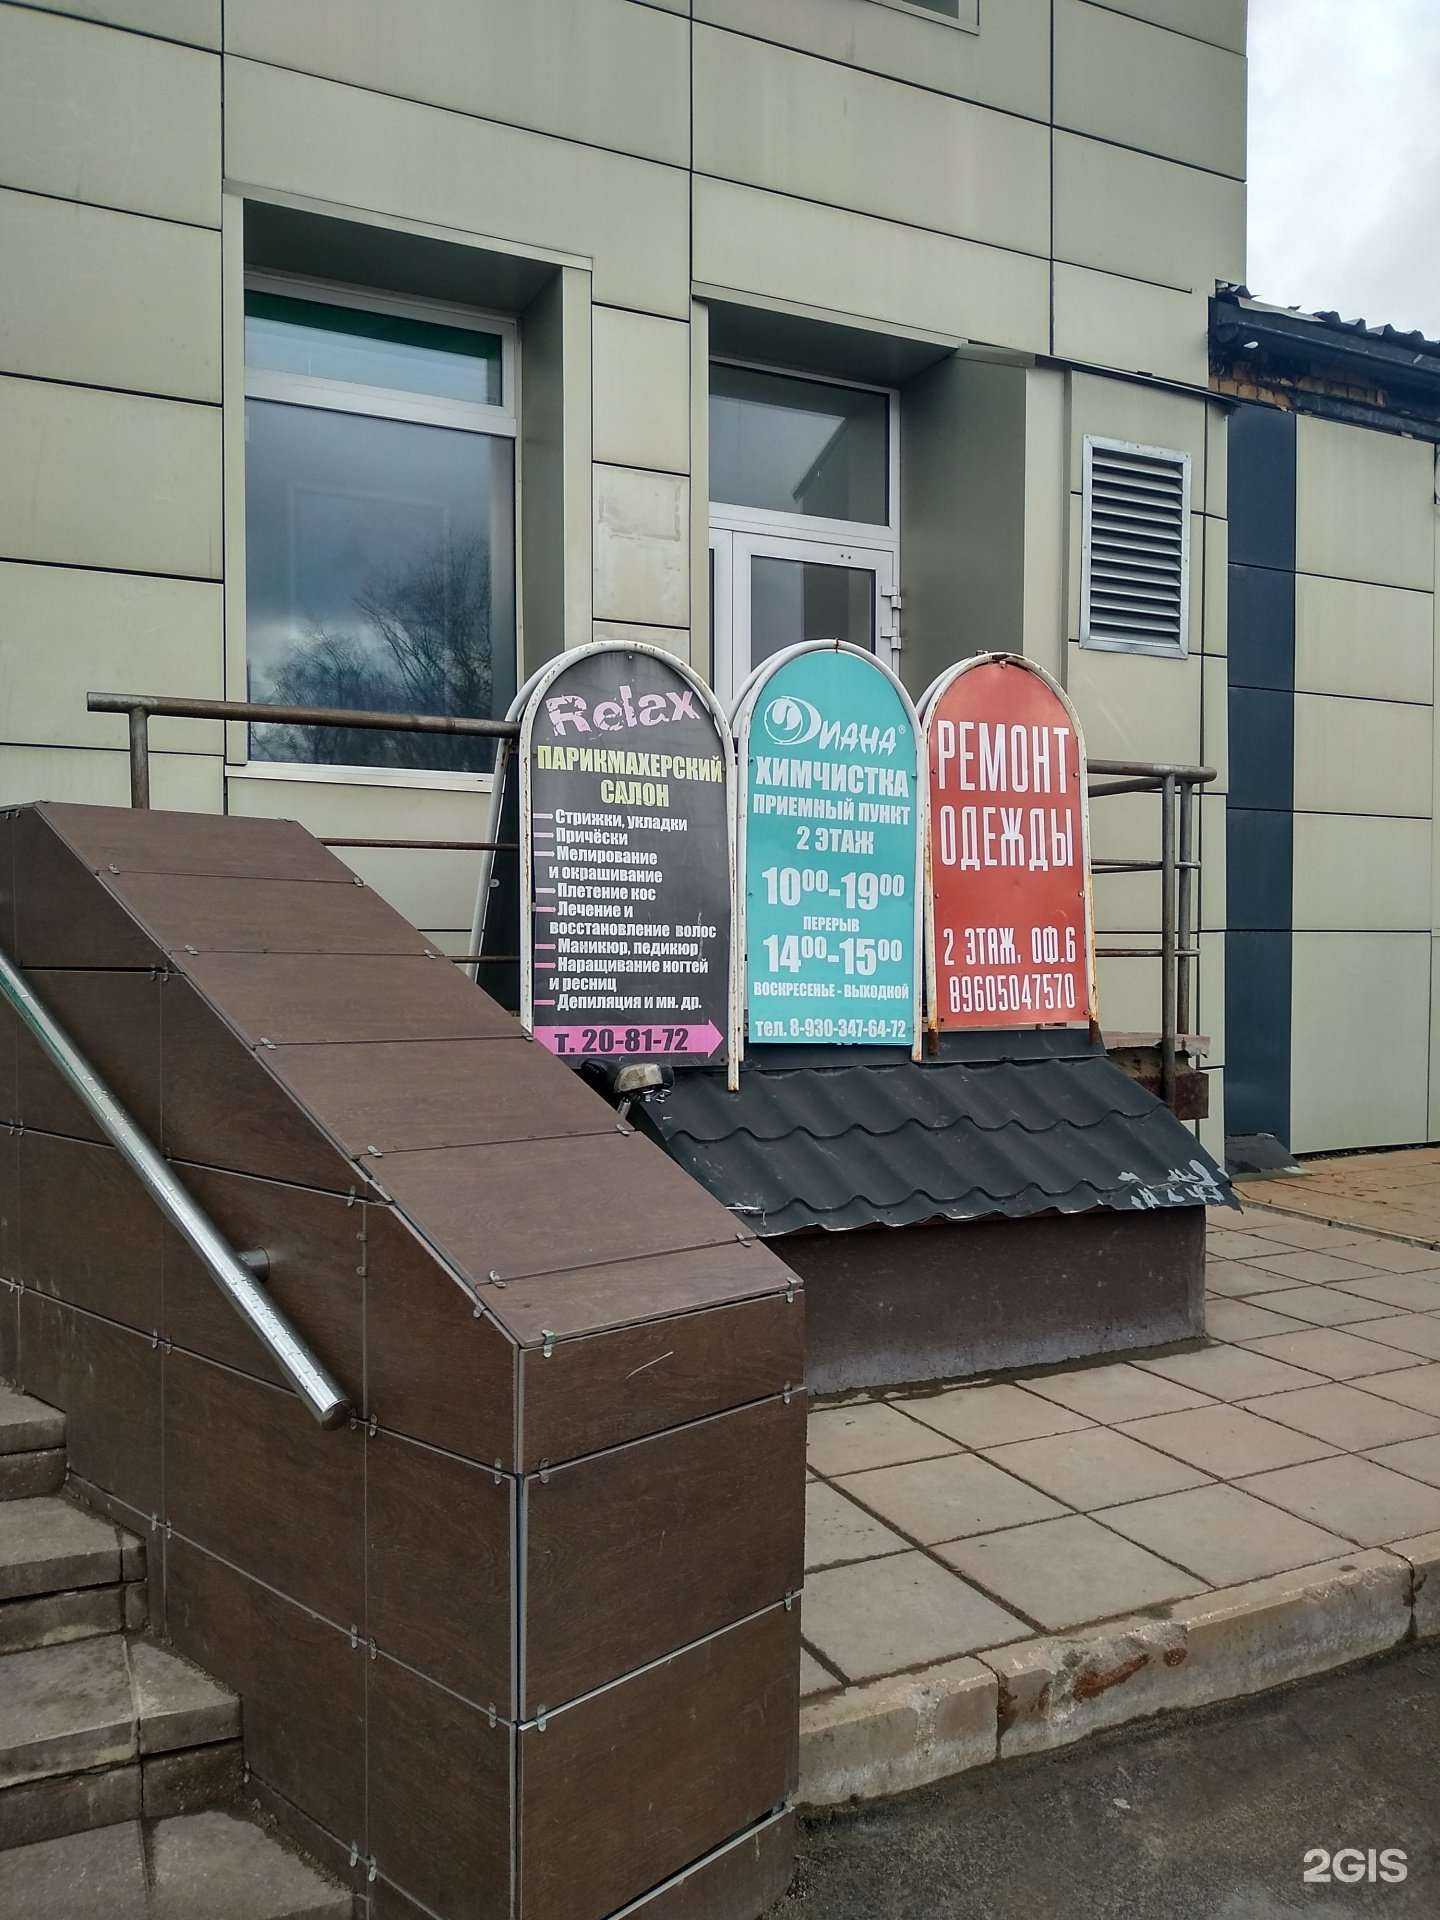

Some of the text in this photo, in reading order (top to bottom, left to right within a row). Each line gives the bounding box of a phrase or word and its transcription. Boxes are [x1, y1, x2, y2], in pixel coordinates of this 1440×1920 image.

[546, 686, 700, 736] Relax
[537, 745, 723, 783] ПАРИКМАХЕРСКИЙ
[938, 720, 1069, 793] РЕМОНТ
[756, 756, 909, 798] ХИМЧИСТКА
[600, 780, 669, 807] САЛОН
[753, 793, 910, 825] ПРИЕМНЫЙ ПУНКТ
[556, 809, 687, 832] Стрижки, укладки
[556, 828, 628, 845] Причёски
[797, 826, 874, 854] 2 ЭТАЖ
[940, 806, 1074, 871] ОДЕЖДЫ
[556, 846, 657, 864] Мелирование
[549, 867, 663, 883] и окрашивание
[558, 883, 656, 900] Плетение кос
[557, 901, 633, 918] Лечение и
[550, 922, 716, 938] восстановление волос
[803, 916, 860, 932] ПЕРЕРЫВ
[558, 939, 698, 956] Маникюр, педикюр
[944, 928, 954, 966] 2
[558, 957, 708, 973] Наращивание ногтей
[549, 978, 617, 992] и ресниц
[754, 982, 835, 998] ВОСКРЕСЕНЬЕ
[844, 984, 908, 1000] ВЫХОДНОЙ
[950, 973, 1075, 1012] 89605047570
[557, 994, 702, 1011] Депиляция и мн. др.
[755, 1018, 906, 1038] тел. 8-930-347-64-72
[582, 1028, 689, 1053] 20-81-72
